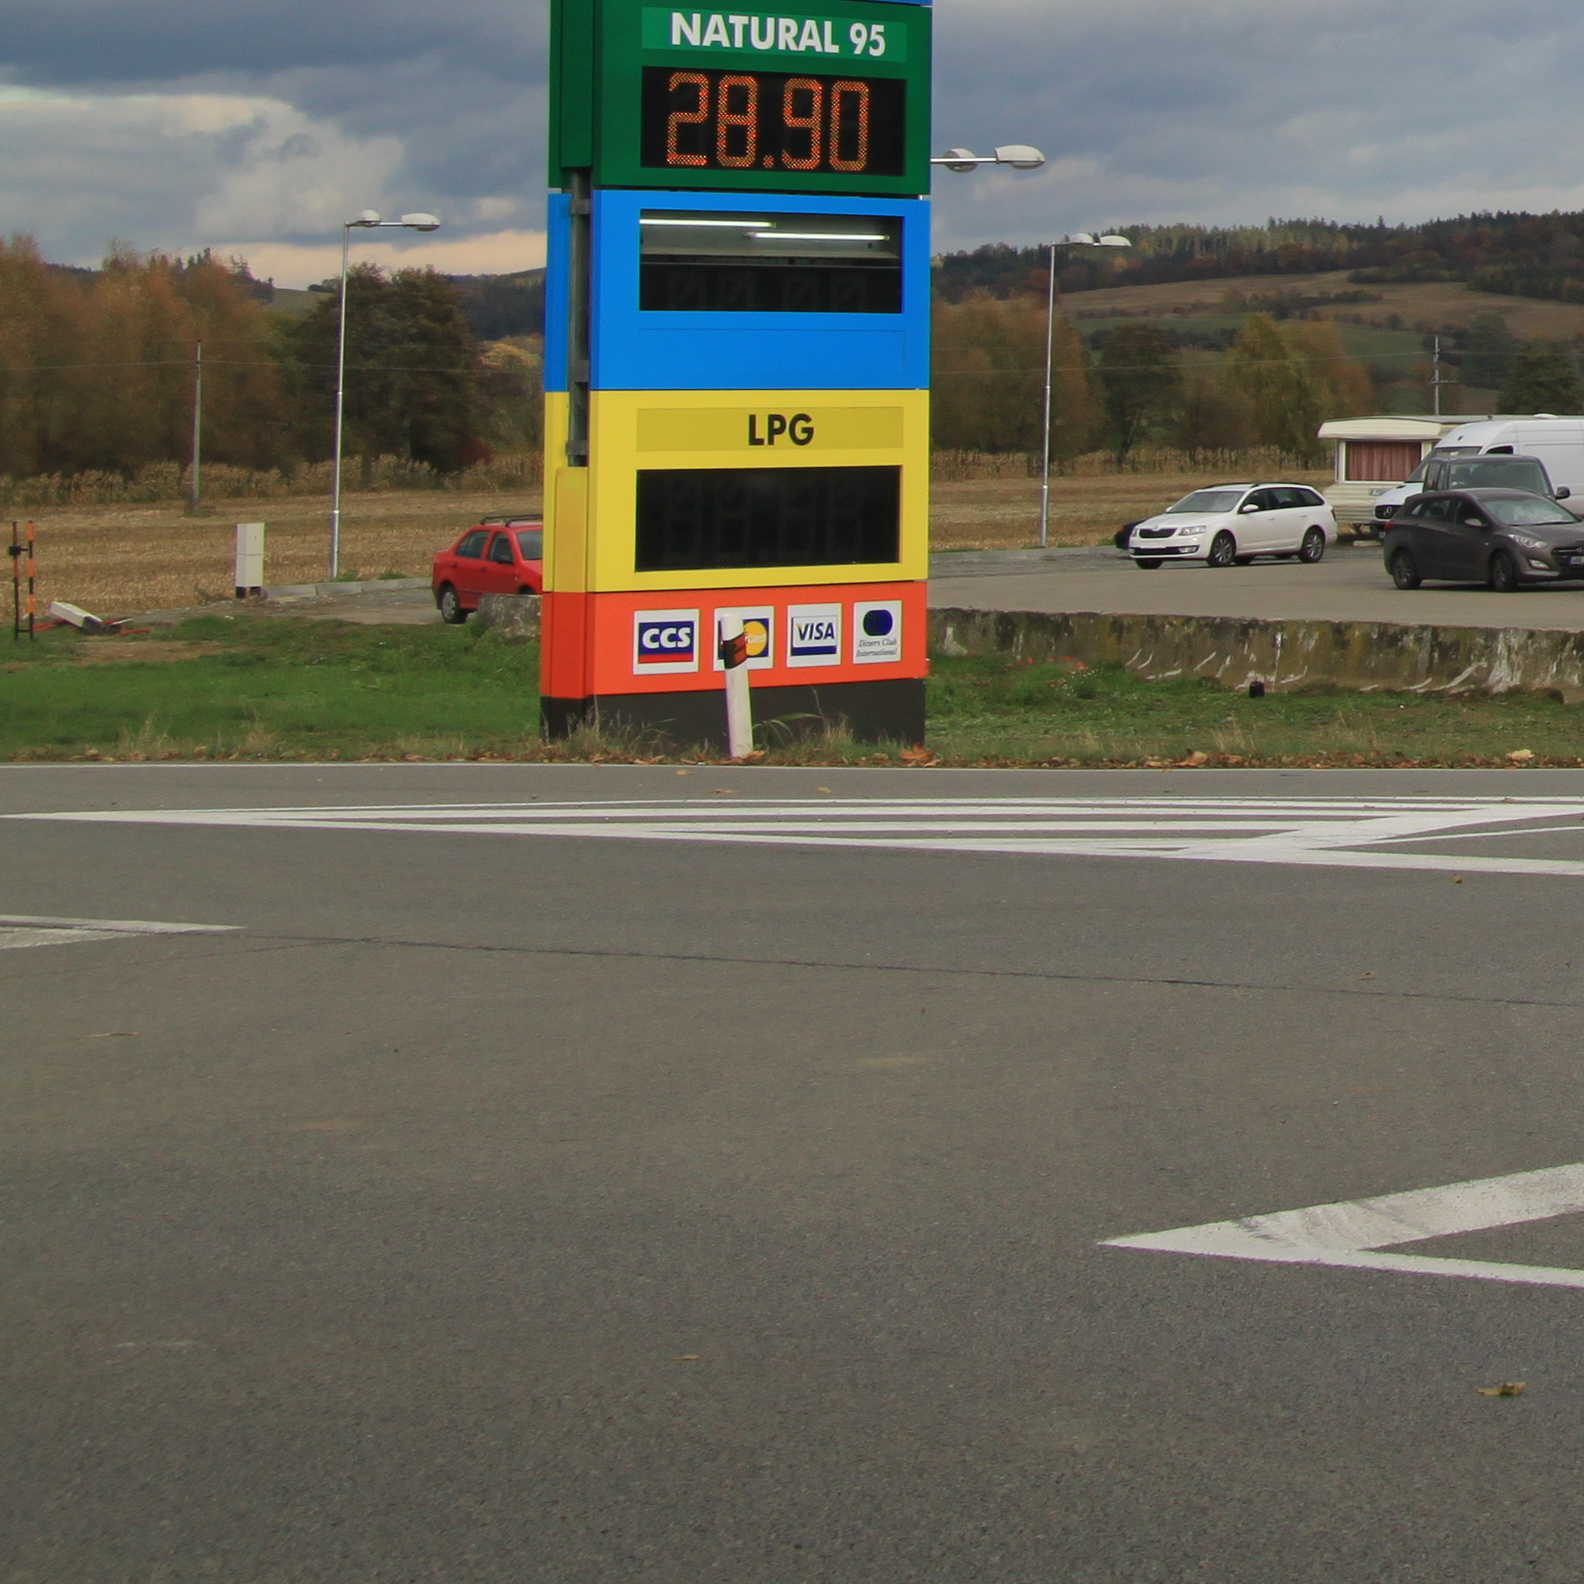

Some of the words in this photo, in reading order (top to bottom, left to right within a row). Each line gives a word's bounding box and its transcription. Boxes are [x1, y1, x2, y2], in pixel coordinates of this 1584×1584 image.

[670, 11, 840, 54] NATURAL
[849, 23, 886, 57] 95
[666, 71, 870, 172] 28.90
[748, 413, 815, 446] LPG
[642, 627, 691, 649] CCS
[795, 622, 835, 641] VISA
